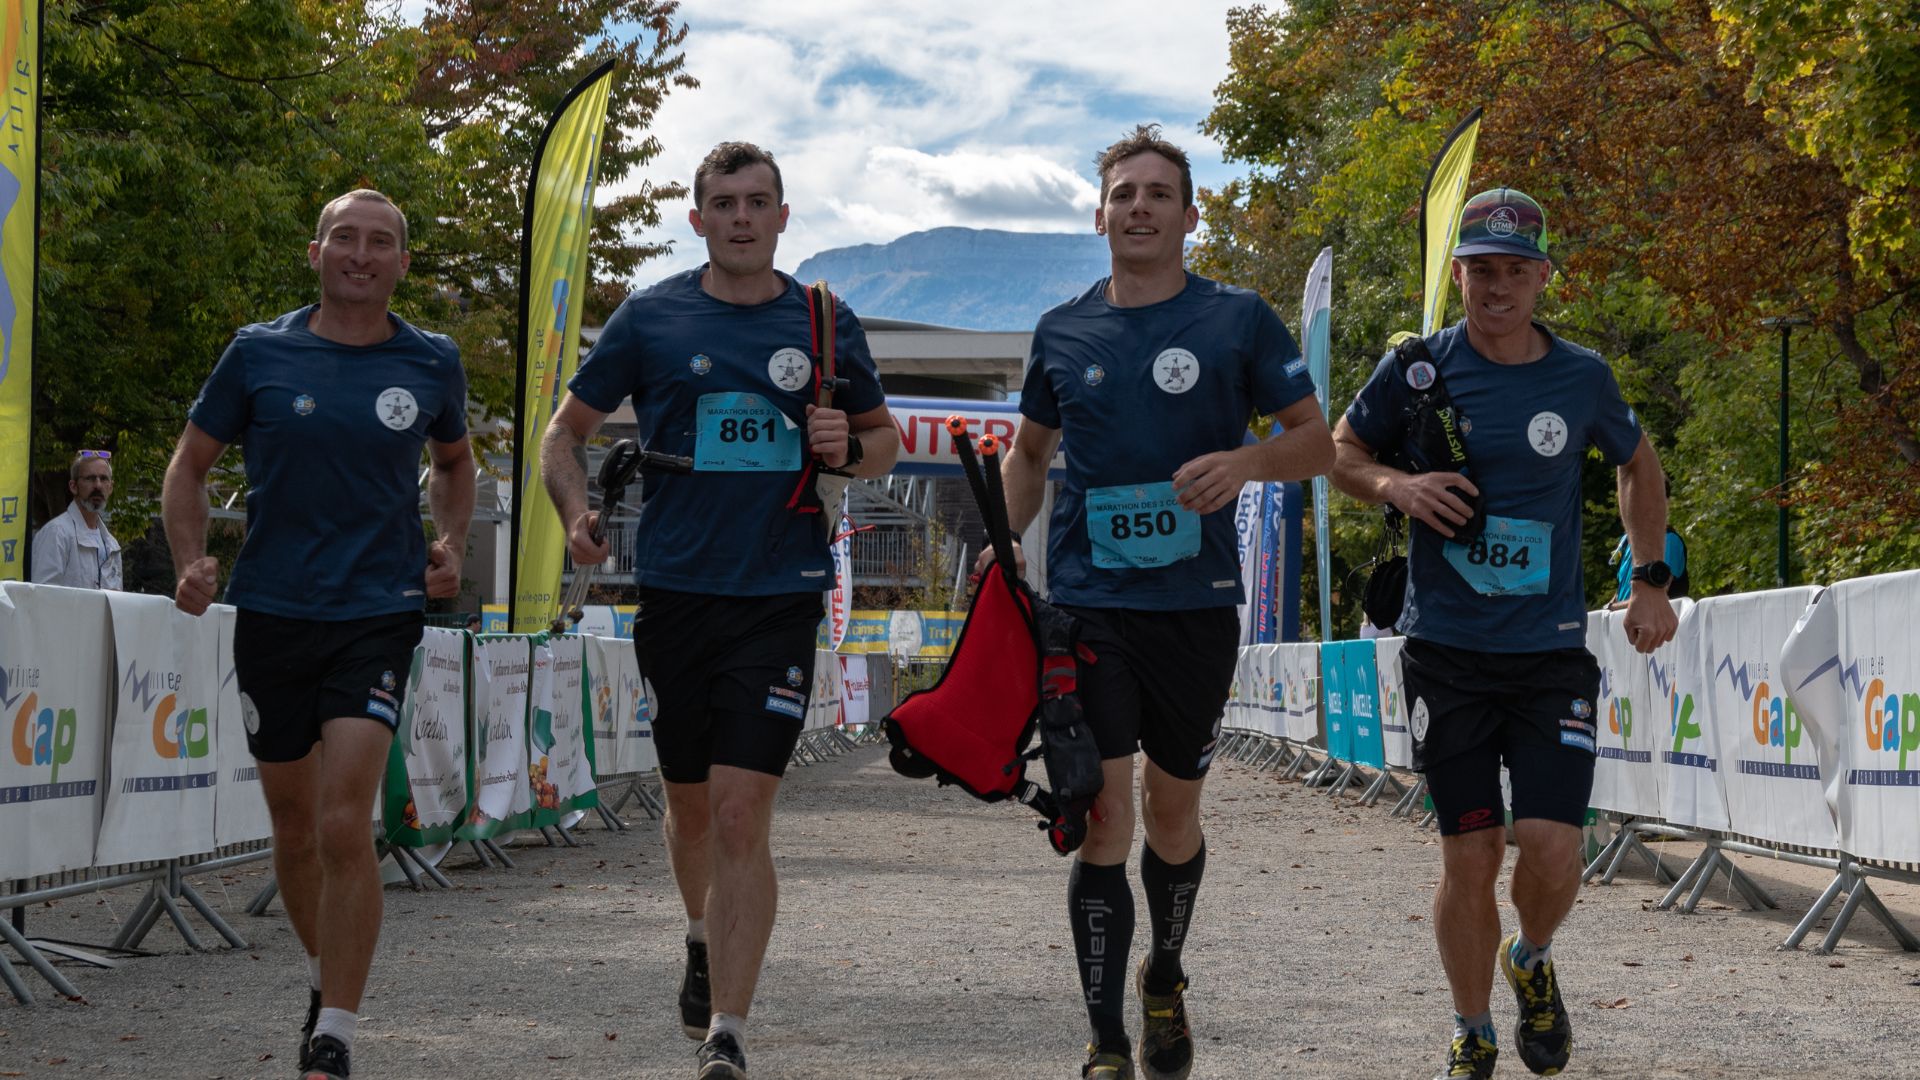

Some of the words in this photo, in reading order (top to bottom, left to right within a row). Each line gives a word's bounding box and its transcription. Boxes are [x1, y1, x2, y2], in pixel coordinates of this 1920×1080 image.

[707, 408, 748, 416] MARATHON
[749, 408, 765, 416] DES
[719, 418, 776, 443] 861
[1096, 502, 1139, 512] MARATHON
[1141, 501, 1158, 509] DES
[1111, 509, 1177, 540] 850
[1467, 541, 1530, 569] 884
[12, 691, 77, 784] Gap
[1753, 681, 1802, 765] Gap
[1162, 882, 1196, 950] kalenji
[1081, 898, 1113, 1005] kalenji
